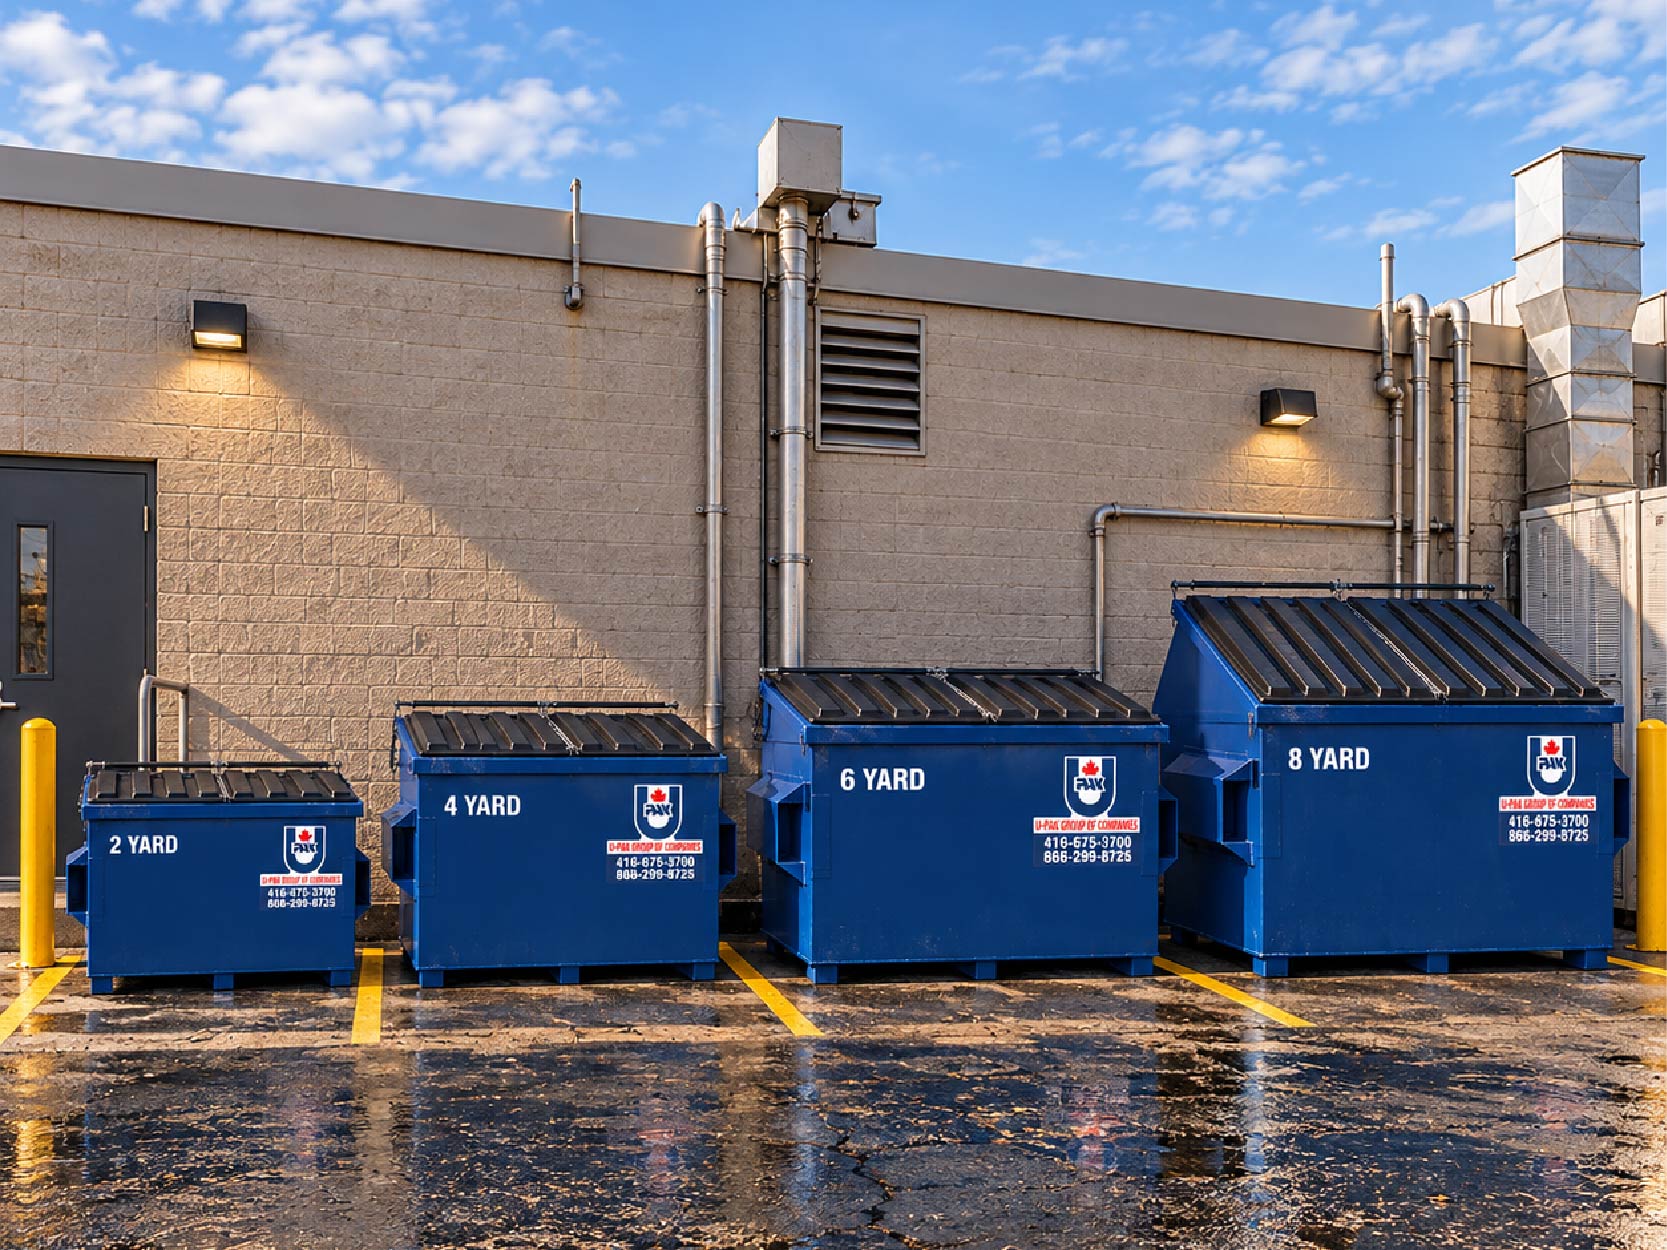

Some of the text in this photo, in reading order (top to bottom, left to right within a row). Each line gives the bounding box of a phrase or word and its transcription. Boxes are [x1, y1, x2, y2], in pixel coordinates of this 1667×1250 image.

[1288, 747, 1370, 770] 8 YARD
[840, 768, 925, 791] 6 YARD
[444, 794, 521, 816] 4 YARD
[1508, 814, 1589, 828] 416-675-3700
[109, 834, 178, 855] 2 YARD
[1508, 829, 1589, 842] 866-299-8725
